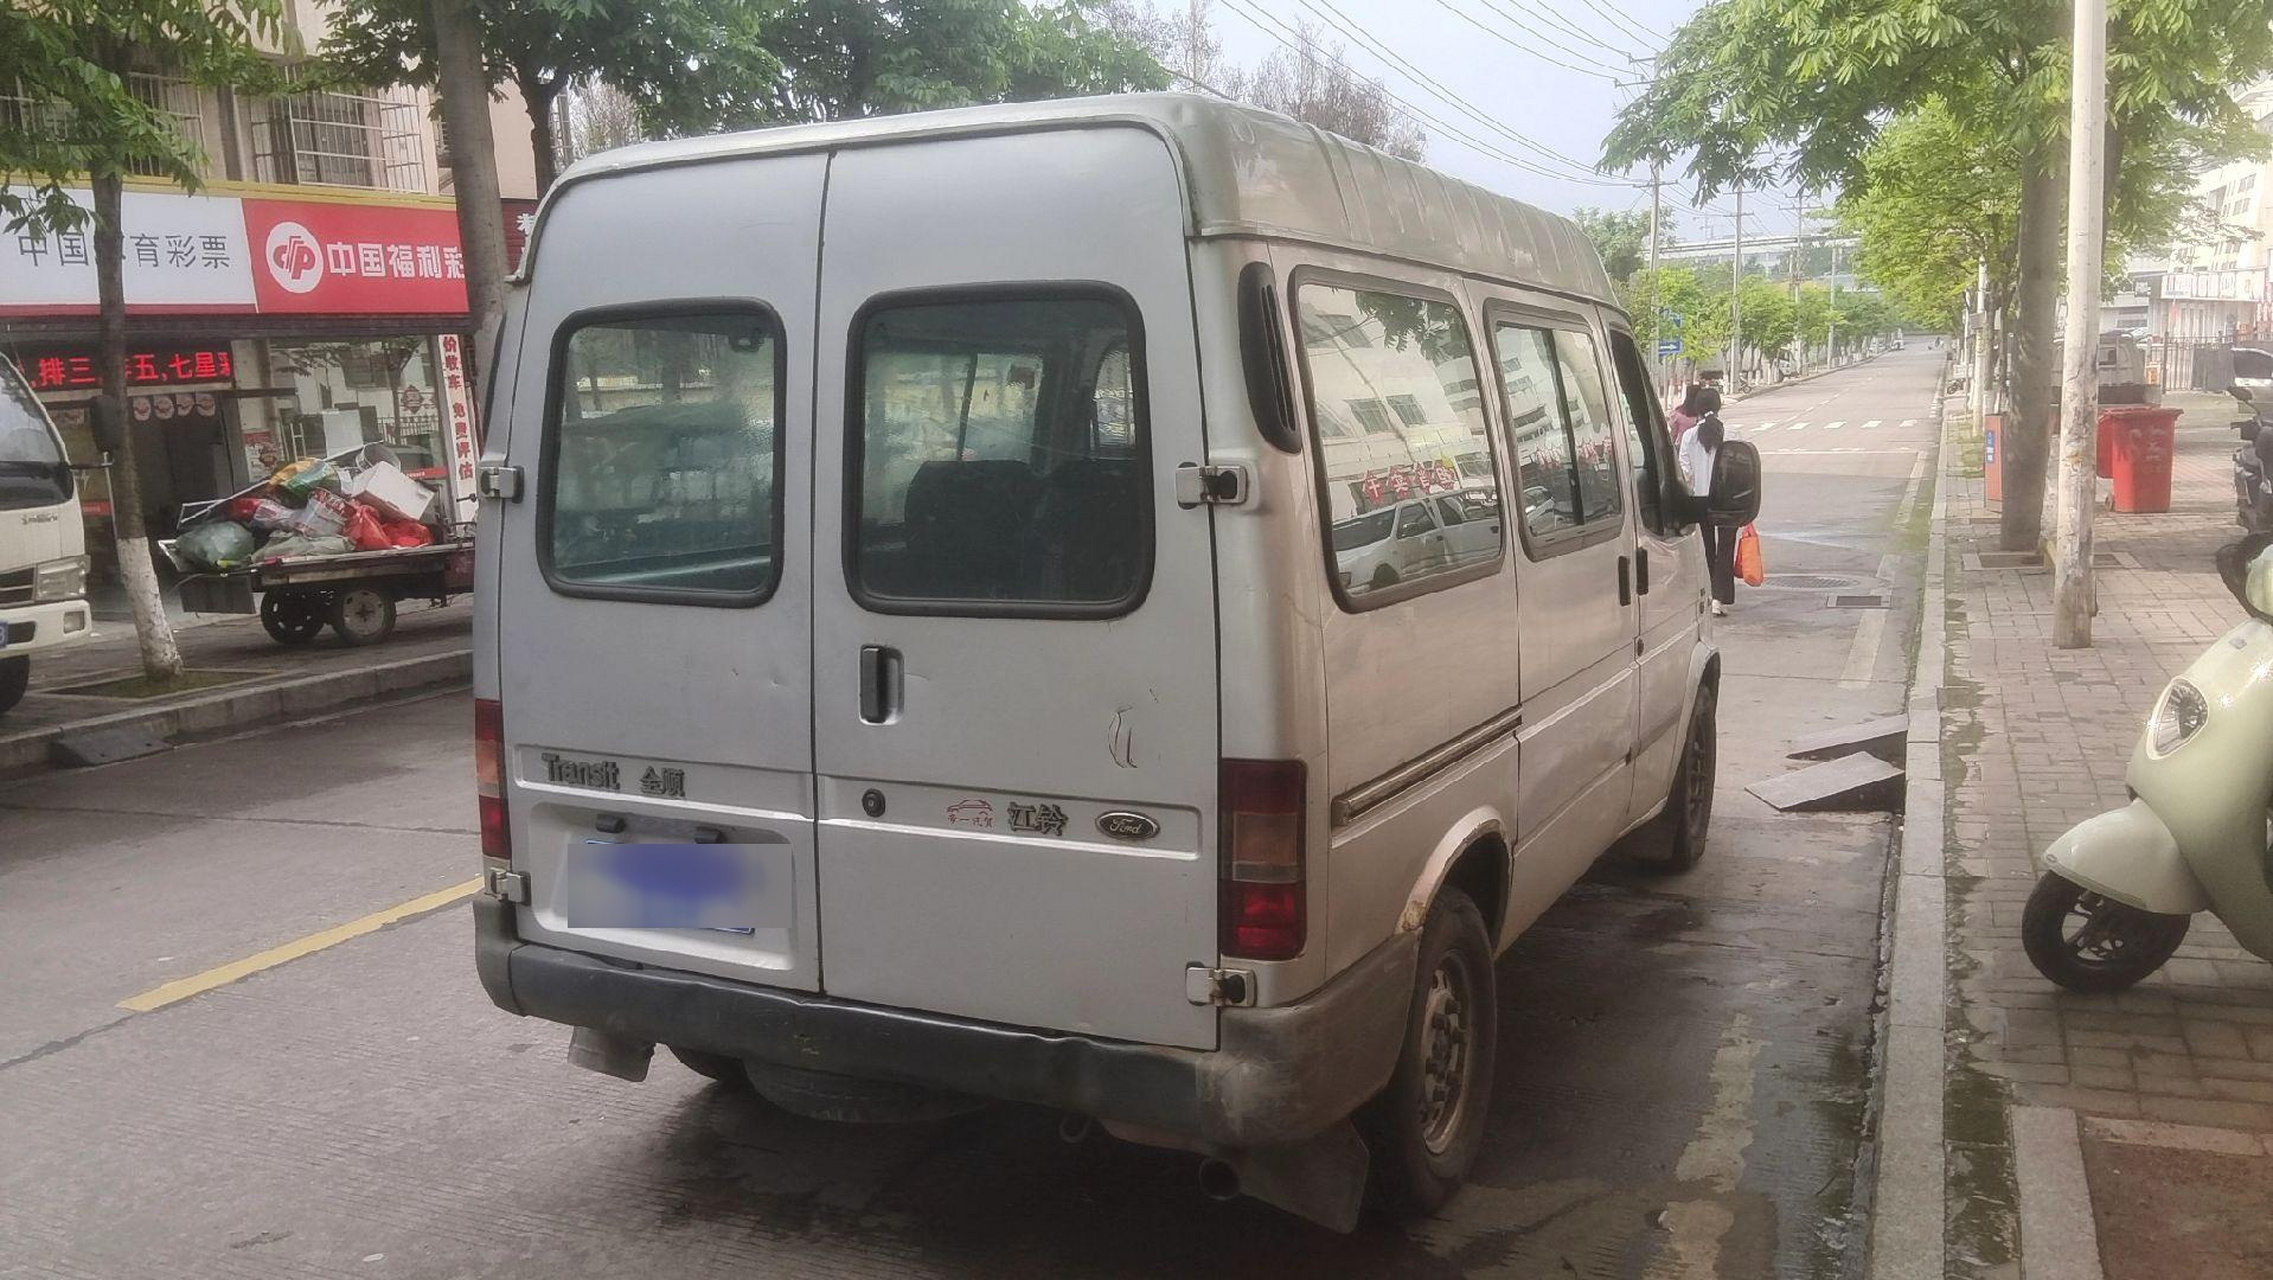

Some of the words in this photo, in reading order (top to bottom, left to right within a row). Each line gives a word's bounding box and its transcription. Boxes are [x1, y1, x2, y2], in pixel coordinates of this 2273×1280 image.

[18, 232, 230, 269] 中国育彩票
[541, 752, 622, 791] Transit
[639, 765, 686, 798] 全顺
[1007, 801, 1069, 837] 江铃
